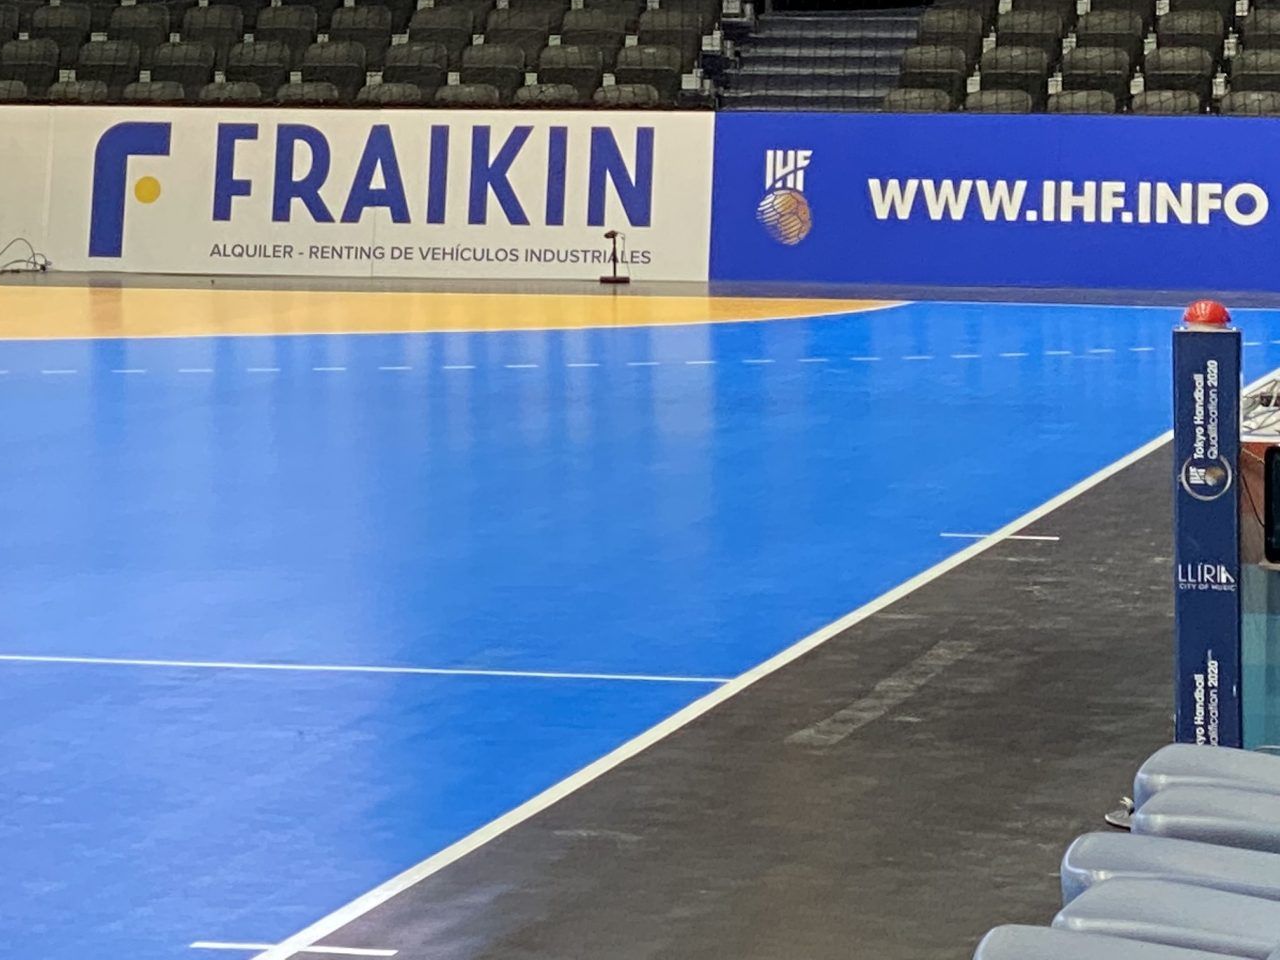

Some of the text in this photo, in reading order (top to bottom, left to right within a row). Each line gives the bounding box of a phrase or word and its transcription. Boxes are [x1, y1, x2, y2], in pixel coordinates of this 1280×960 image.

[212, 122, 655, 227] FRAIKIN
[764, 149, 813, 191] IHF
[867, 178, 1269, 226] WWW.IHF.INFO
[209, 243, 294, 260] ALQUILER
[308, 245, 385, 261] RENTING
[390, 246, 414, 261] DE
[418, 243, 520, 263] VEHÍCULOS
[524, 247, 652, 265] INDUSTRIALES
[1192, 373, 1206, 460] Tokyo Handball
[1206, 360, 1219, 460] Qualification 2020
[1207, 660, 1219, 687] 2020
[1193, 673, 1206, 725] Handball
